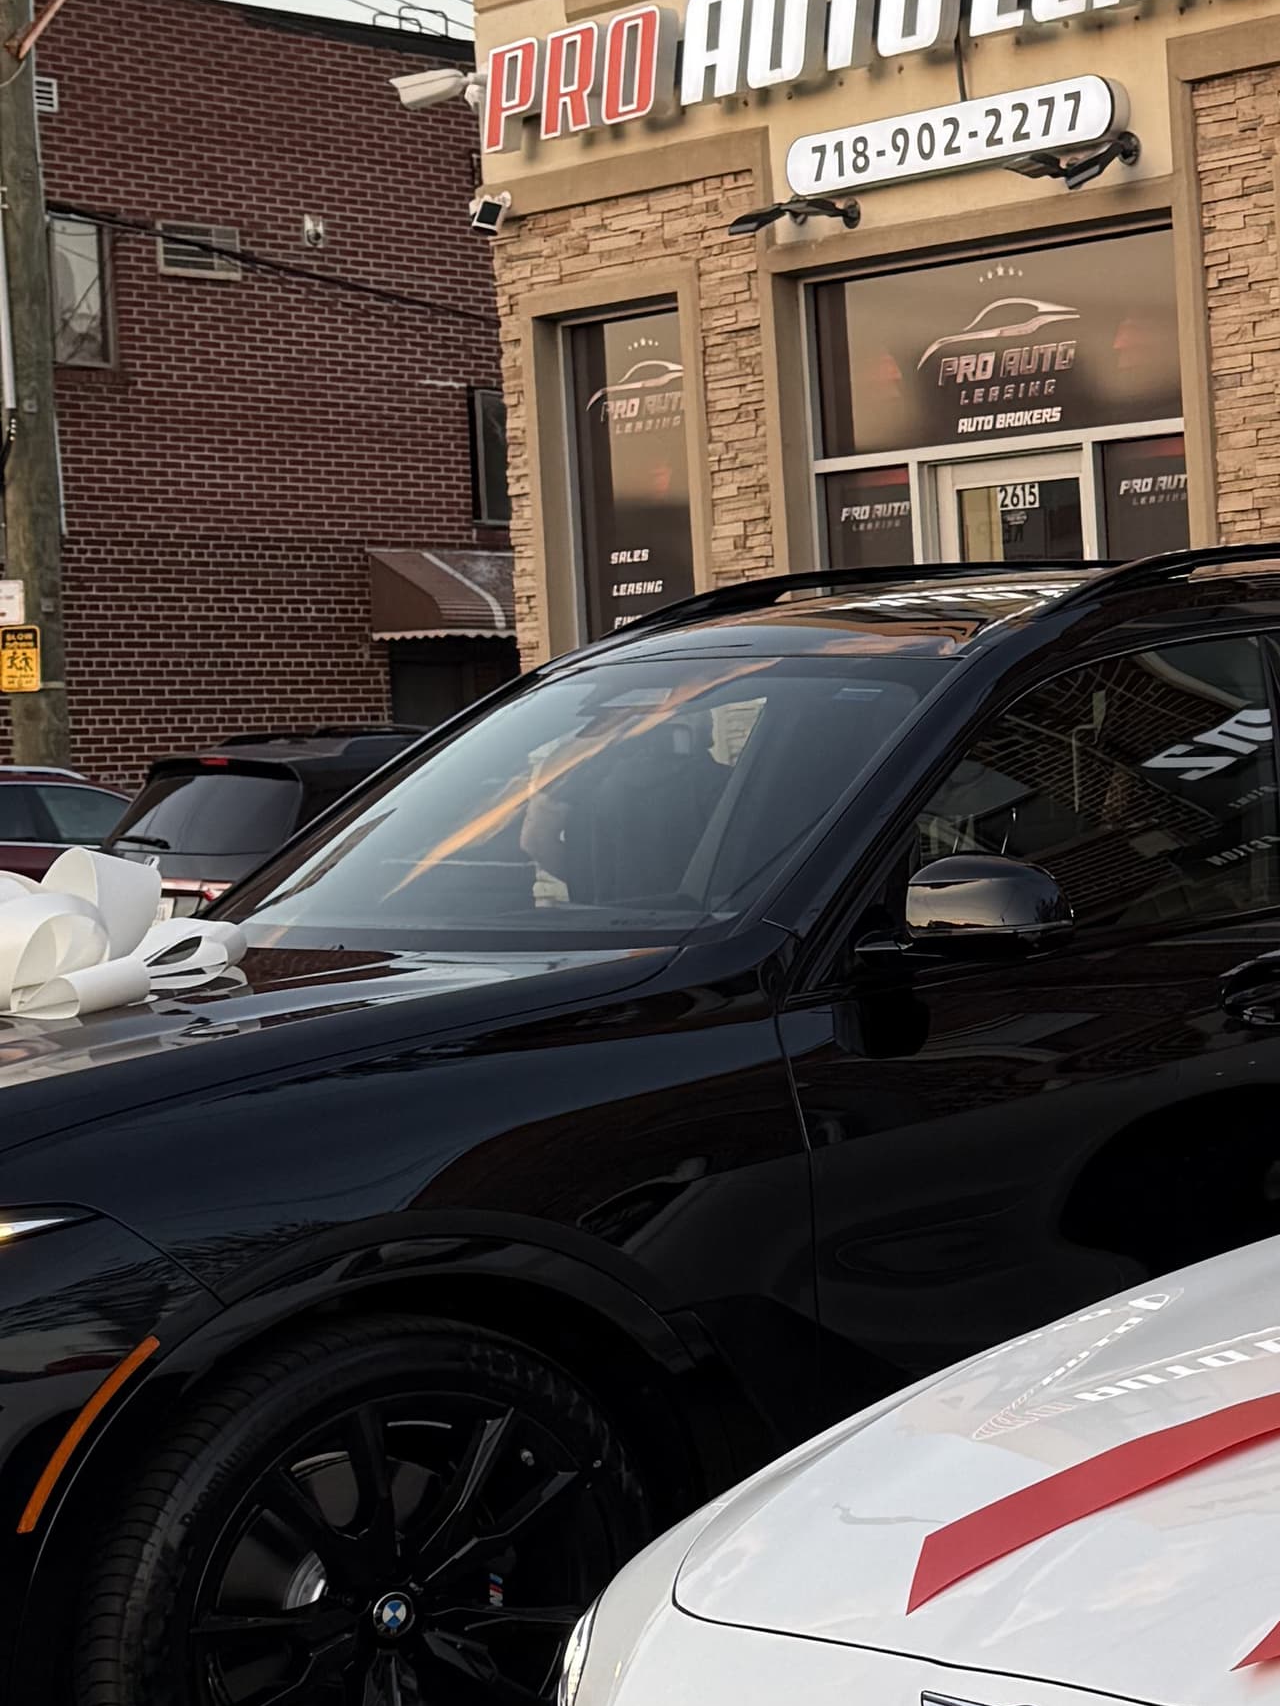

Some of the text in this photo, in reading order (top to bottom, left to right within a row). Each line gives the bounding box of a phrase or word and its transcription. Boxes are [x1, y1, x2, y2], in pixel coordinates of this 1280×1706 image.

[483, 5, 670, 153] PRO
[810, 91, 1083, 184] 718-902-2277
[938, 340, 1077, 386] PRO AUTO
[960, 379, 1057, 406] LEASING
[958, 407, 1062, 434] AUTO BROKERS
[1000, 484, 1038, 509] 2615
[1119, 473, 1188, 495] PRO AUT
[841, 500, 910, 522] PRO AUTO
[610, 549, 650, 564] SALES
[612, 580, 663, 596] LEASING
